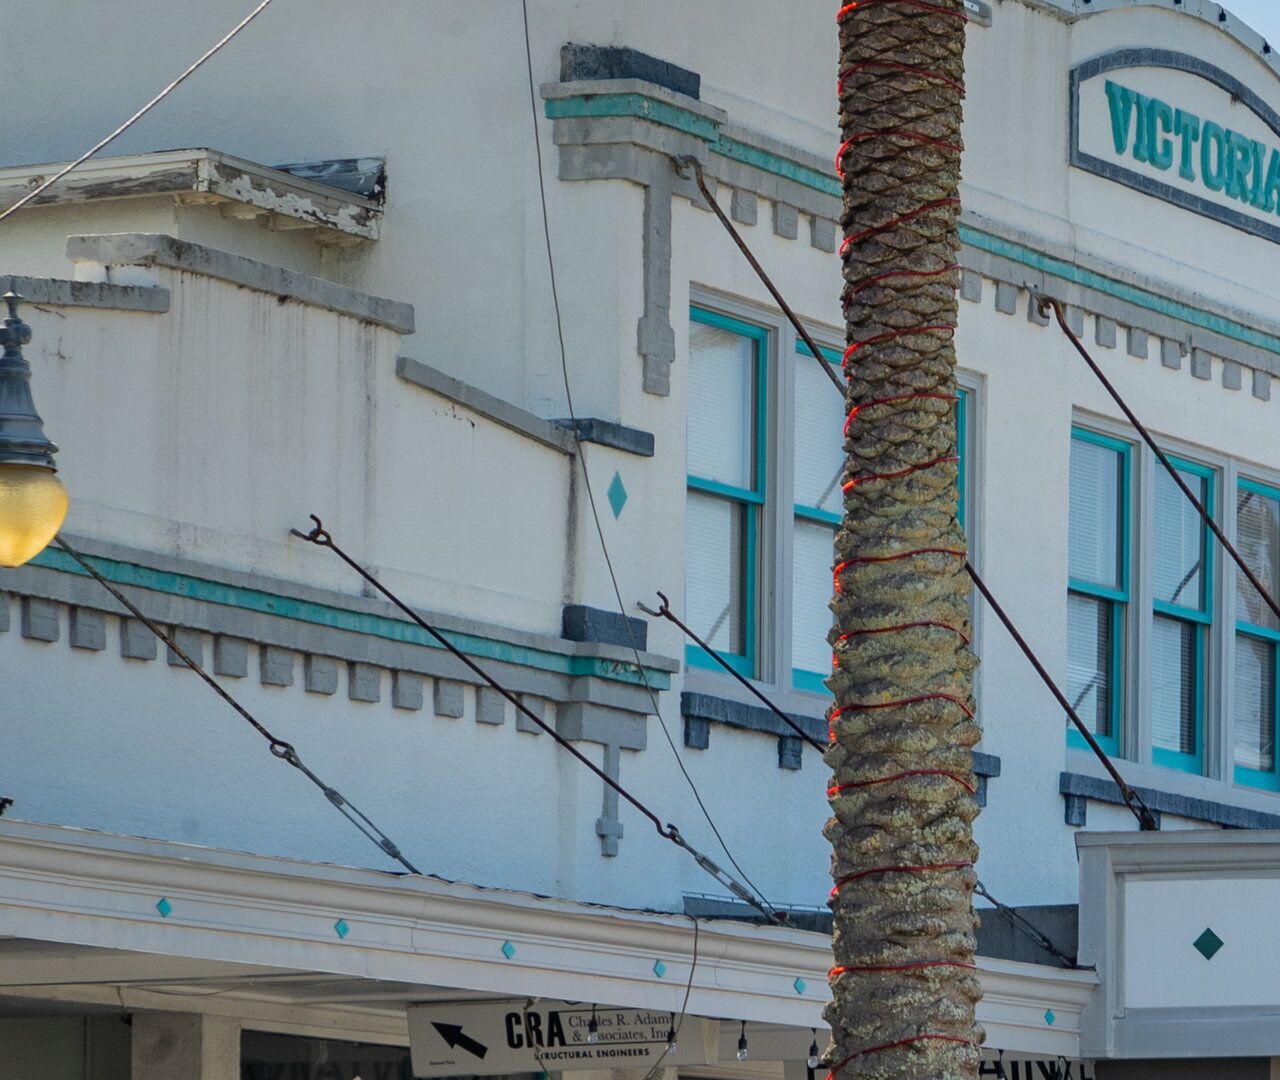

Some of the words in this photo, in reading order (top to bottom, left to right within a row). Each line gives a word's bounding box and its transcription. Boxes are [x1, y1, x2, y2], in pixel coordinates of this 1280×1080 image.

[568, 1014, 613, 1028] Chales
[617, 1014, 630, 1027] R.
[633, 1012, 673, 1026] Adams
[505, 1012, 566, 1048] CRA
[572, 1031, 582, 1042] &
[587, 1028, 648, 1043] ssociates,
[596, 1048, 650, 1059] ENGINEERS
